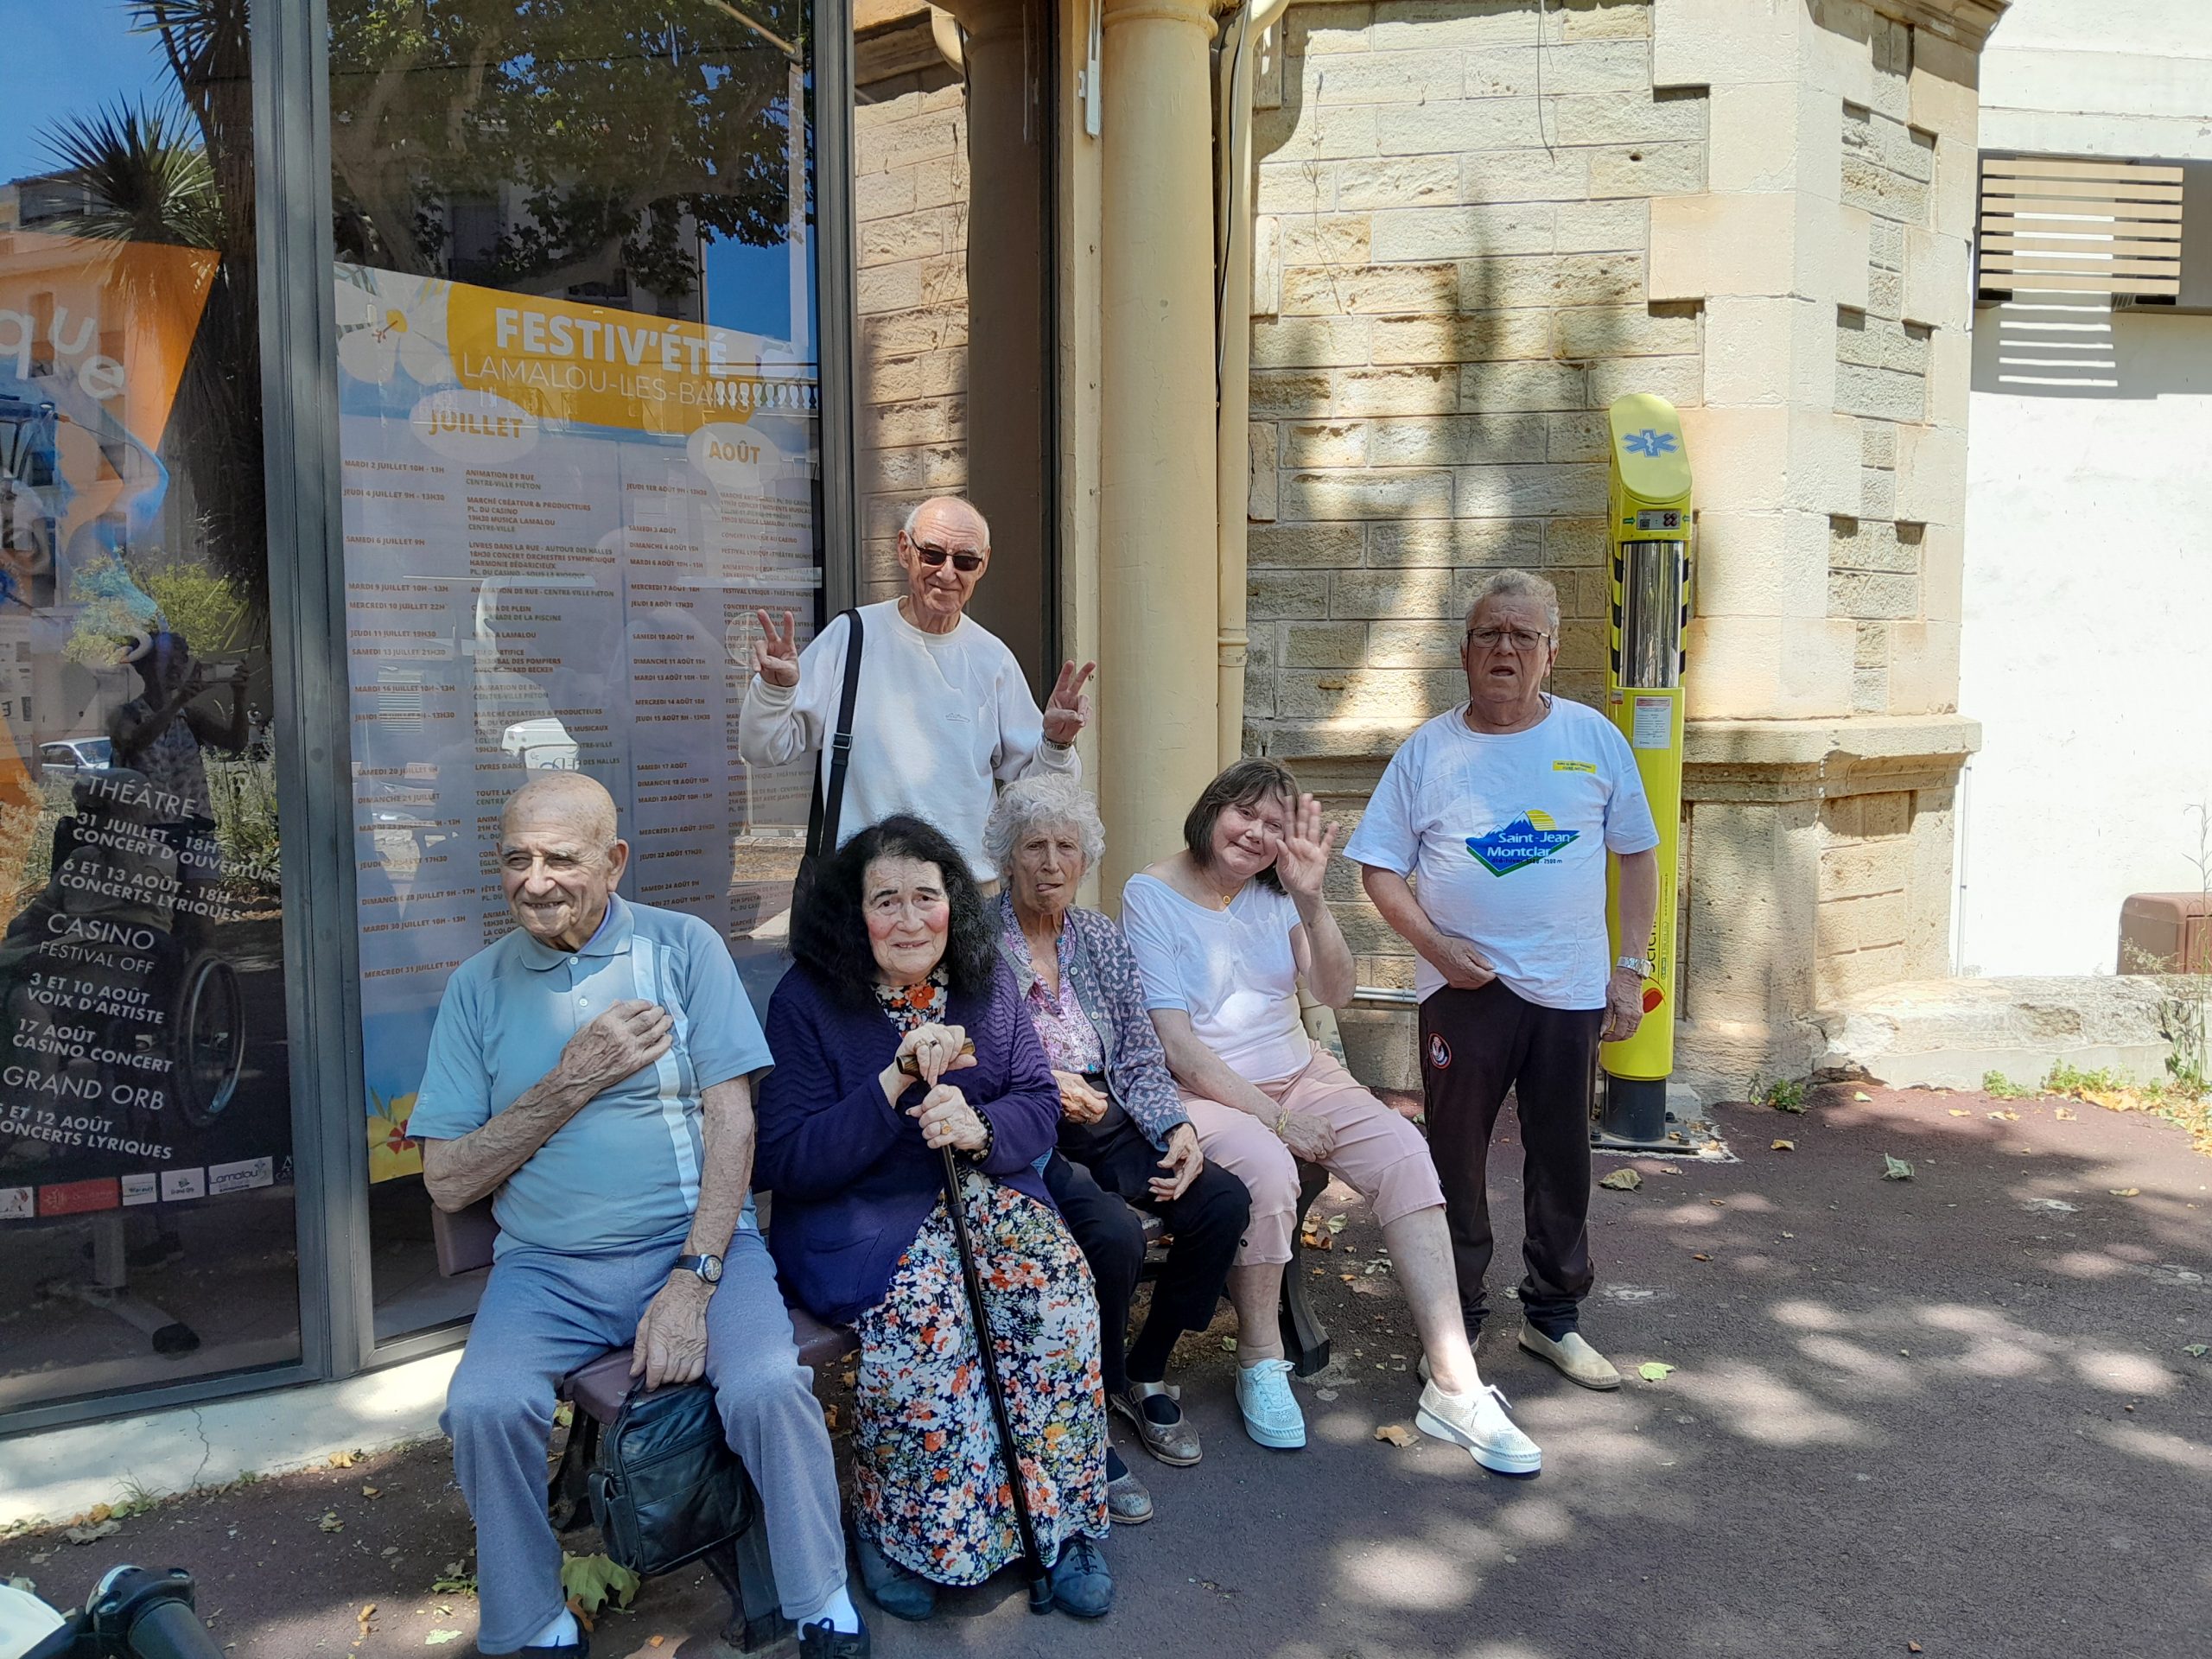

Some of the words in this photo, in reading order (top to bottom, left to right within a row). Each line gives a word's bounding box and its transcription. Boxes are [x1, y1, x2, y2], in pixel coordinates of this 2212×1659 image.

[495, 307, 727, 379] FESTIV'ÉTÉ
[463, 353, 750, 413] LAMALOU-LES-BAINS
[429, 410, 523, 438] JUILLET
[377, 462, 407, 471] JUILLET
[709, 441, 760, 464] AOÛT
[466, 470, 507, 479] ANIMATION
[466, 479, 513, 487] CENTRE-VILLE
[543, 501, 590, 511] PRODUCTEURS
[87, 776, 195, 818] THÉÂTRE
[77, 812, 96, 826] 31
[104, 819, 168, 842] JUILLET
[185, 836, 216, 853] 18H
[73, 828, 156, 856] CONCERT
[161, 848, 281, 884] D'OUVERTURE
[1487, 846, 1551, 857] Montclar
[63, 859, 74, 871] 6
[80, 860, 98, 874] ET
[108, 867, 125, 882] 13
[131, 872, 181, 894] AOÛT
[200, 887, 230, 904] 18H
[60, 874, 151, 903] CONCERTS
[157, 895, 241, 921] LYRIQUES
[362, 895, 404, 906] DIMANCHE
[416, 891, 444, 899] JUILLET
[48, 913, 155, 950] CASINO
[363, 924, 388, 933] MARDI
[401, 919, 429, 929] JUILLET
[39, 942, 113, 968] FESTIVAL
[121, 957, 155, 975] OFF
[365, 967, 404, 978] MERCREDI
[416, 963, 442, 972] JUILLET
[29, 972, 41, 985] 3
[48, 976, 65, 990] ET
[73, 981, 93, 995] 10
[99, 986, 150, 1005] AOÛT
[27, 988, 72, 1009] VOIX
[79, 1000, 165, 1025] D'ARTISTE
[19, 1019, 38, 1033] 17
[43, 1025, 96, 1043] AOÛT
[12, 1034, 84, 1058] CASINO
[91, 1051, 173, 1073] CONCERT
[3, 1066, 101, 1100] GRAND
[111, 1084, 164, 1110] ORB
[10, 1105, 30, 1120] ET
[35, 1110, 54, 1124] 12
[60, 1116, 113, 1134] AOÛT
[87, 1135, 172, 1160] LYRIQUES
[210, 1170, 258, 1184] Lamalou
